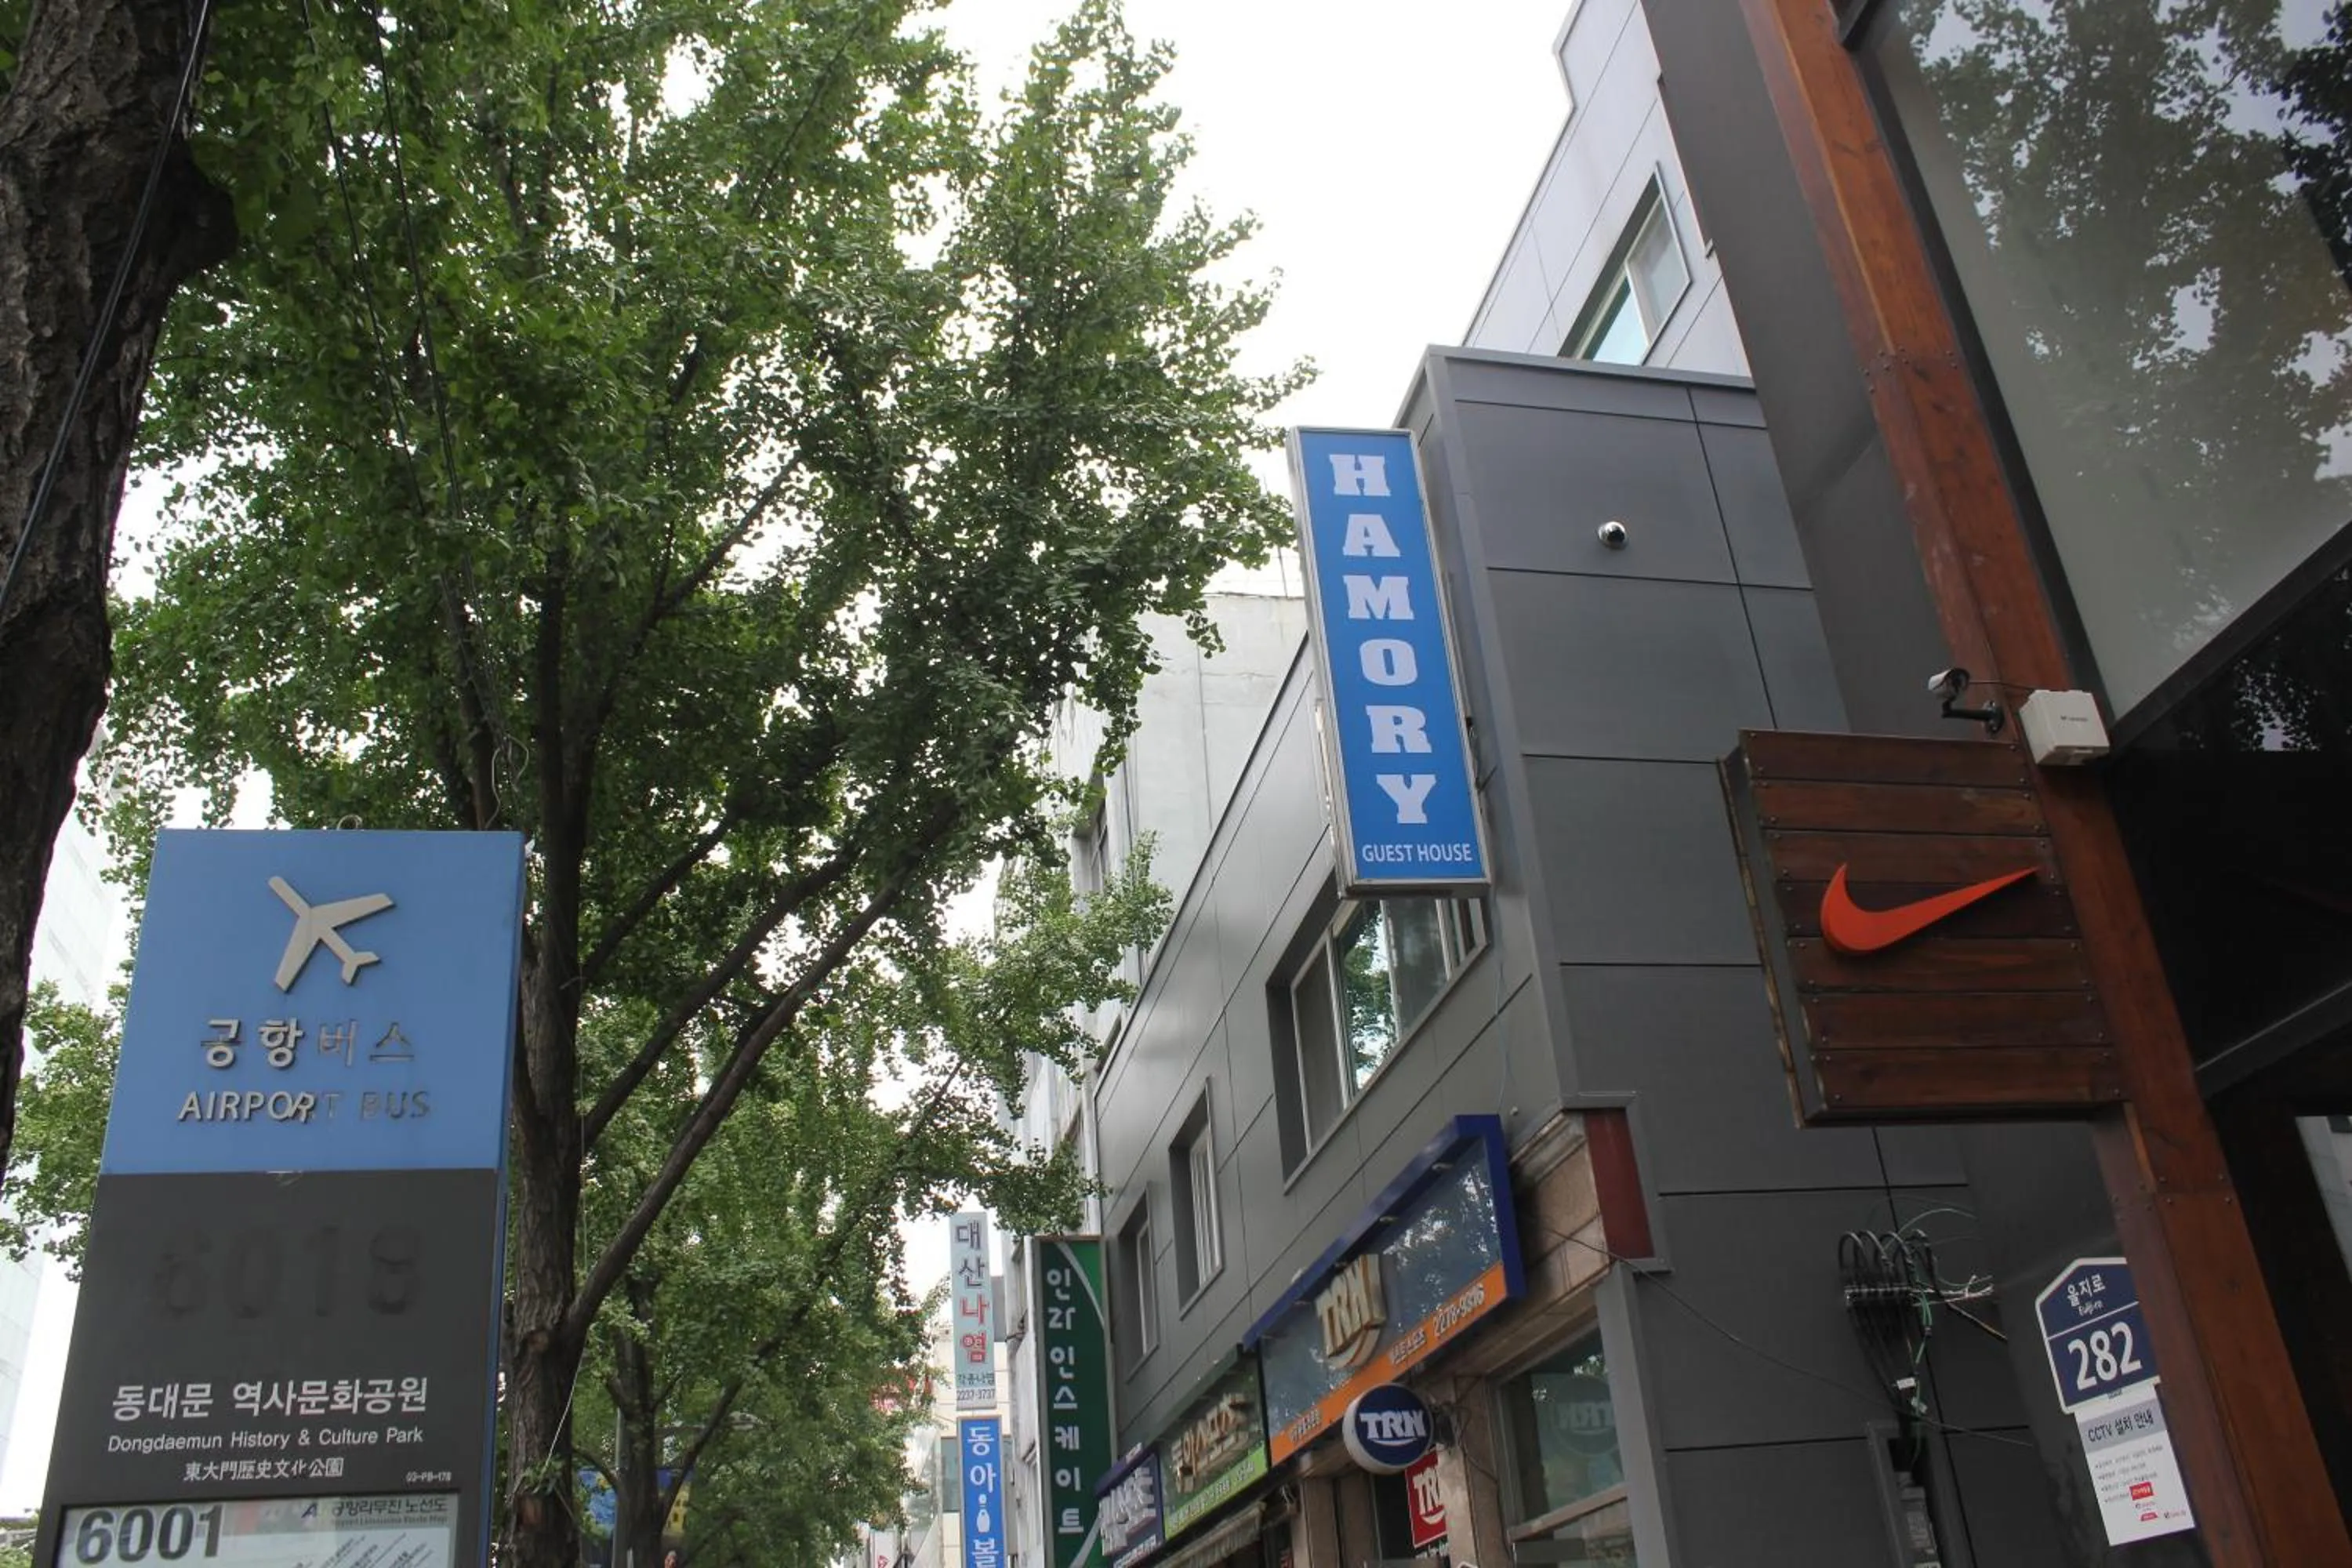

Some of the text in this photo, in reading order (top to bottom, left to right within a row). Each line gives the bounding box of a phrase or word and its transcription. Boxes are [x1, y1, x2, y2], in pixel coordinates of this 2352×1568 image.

[1329, 454, 1437, 824] HAMORY
[1362, 843, 1473, 862] GUEST HOUSE
[200, 1018, 415, 1069] 공항버스
[177, 1091, 430, 1123] AIRPORT BUS
[2067, 1273, 2106, 1307] 을지로
[2067, 1321, 2143, 1391] 282
[113, 1376, 428, 1422] 동대문 역사문화공원
[1046, 1268, 1084, 1534] 인라인스케이트
[107, 1425, 425, 1454] Dongdaemun History & Culture Park
[1359, 1409, 1427, 1440] TRN
[2088, 1423, 2114, 1443] CCTV
[967, 1426, 997, 1494] 동아
[405, 1497, 448, 1514] 노선도
[75, 1504, 224, 1566] 6001
